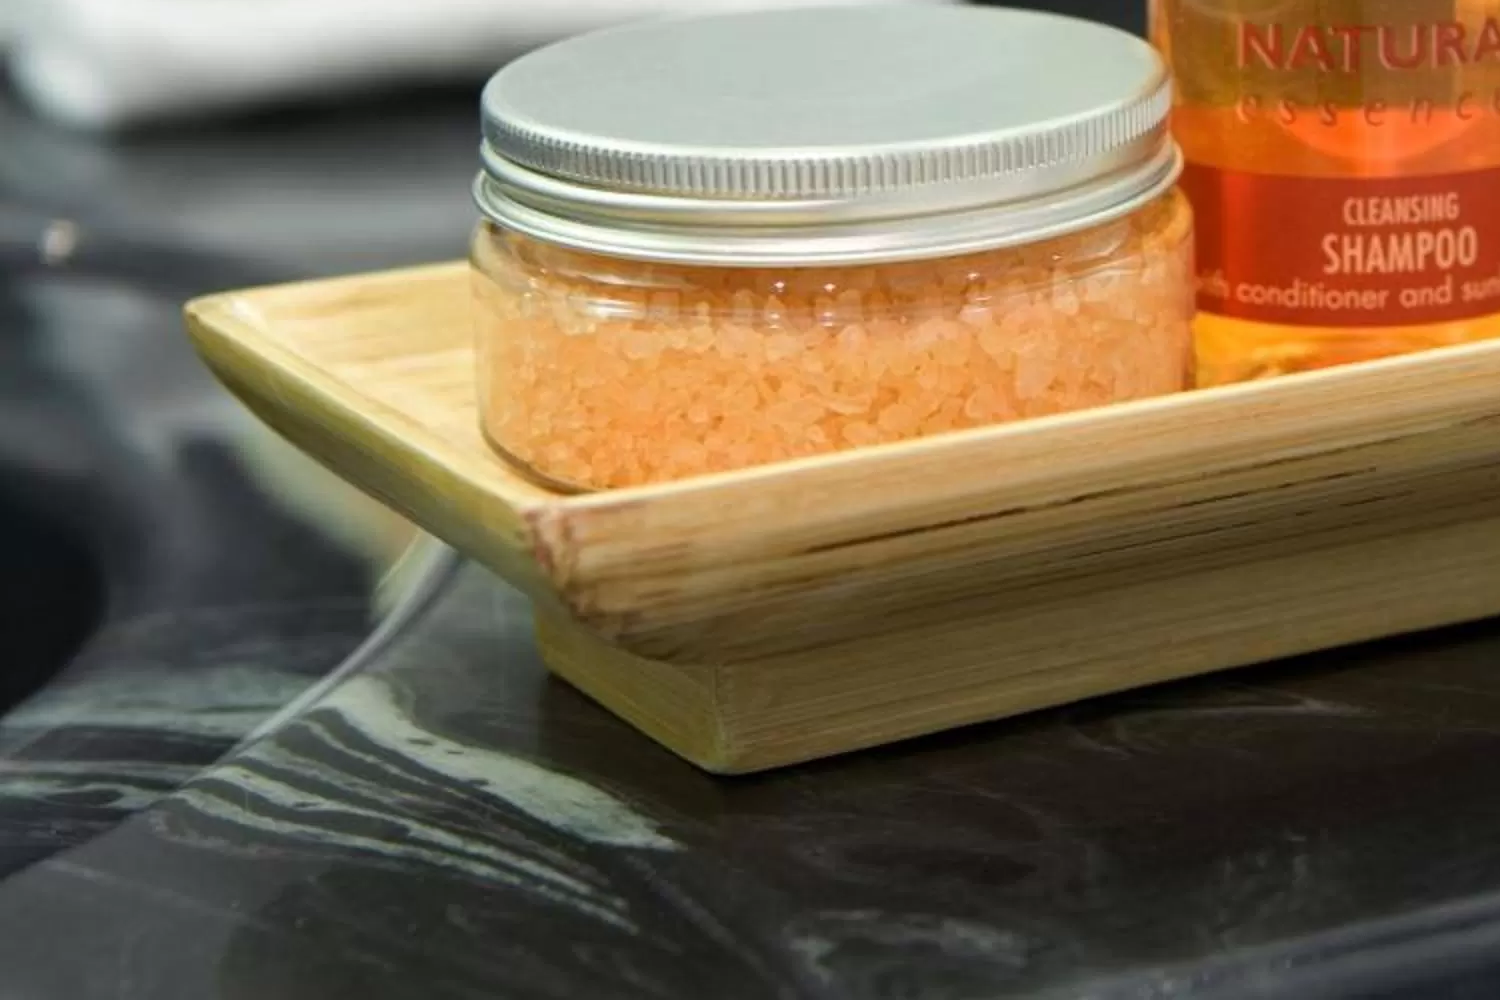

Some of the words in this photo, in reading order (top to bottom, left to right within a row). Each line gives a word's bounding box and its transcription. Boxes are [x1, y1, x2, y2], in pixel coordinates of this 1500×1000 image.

[1343, 192, 1460, 226] CLEANSING
[1321, 226, 1479, 275] SHAMPOO
[1236, 277, 1390, 311] conditioner
[1399, 275, 1452, 308] and
